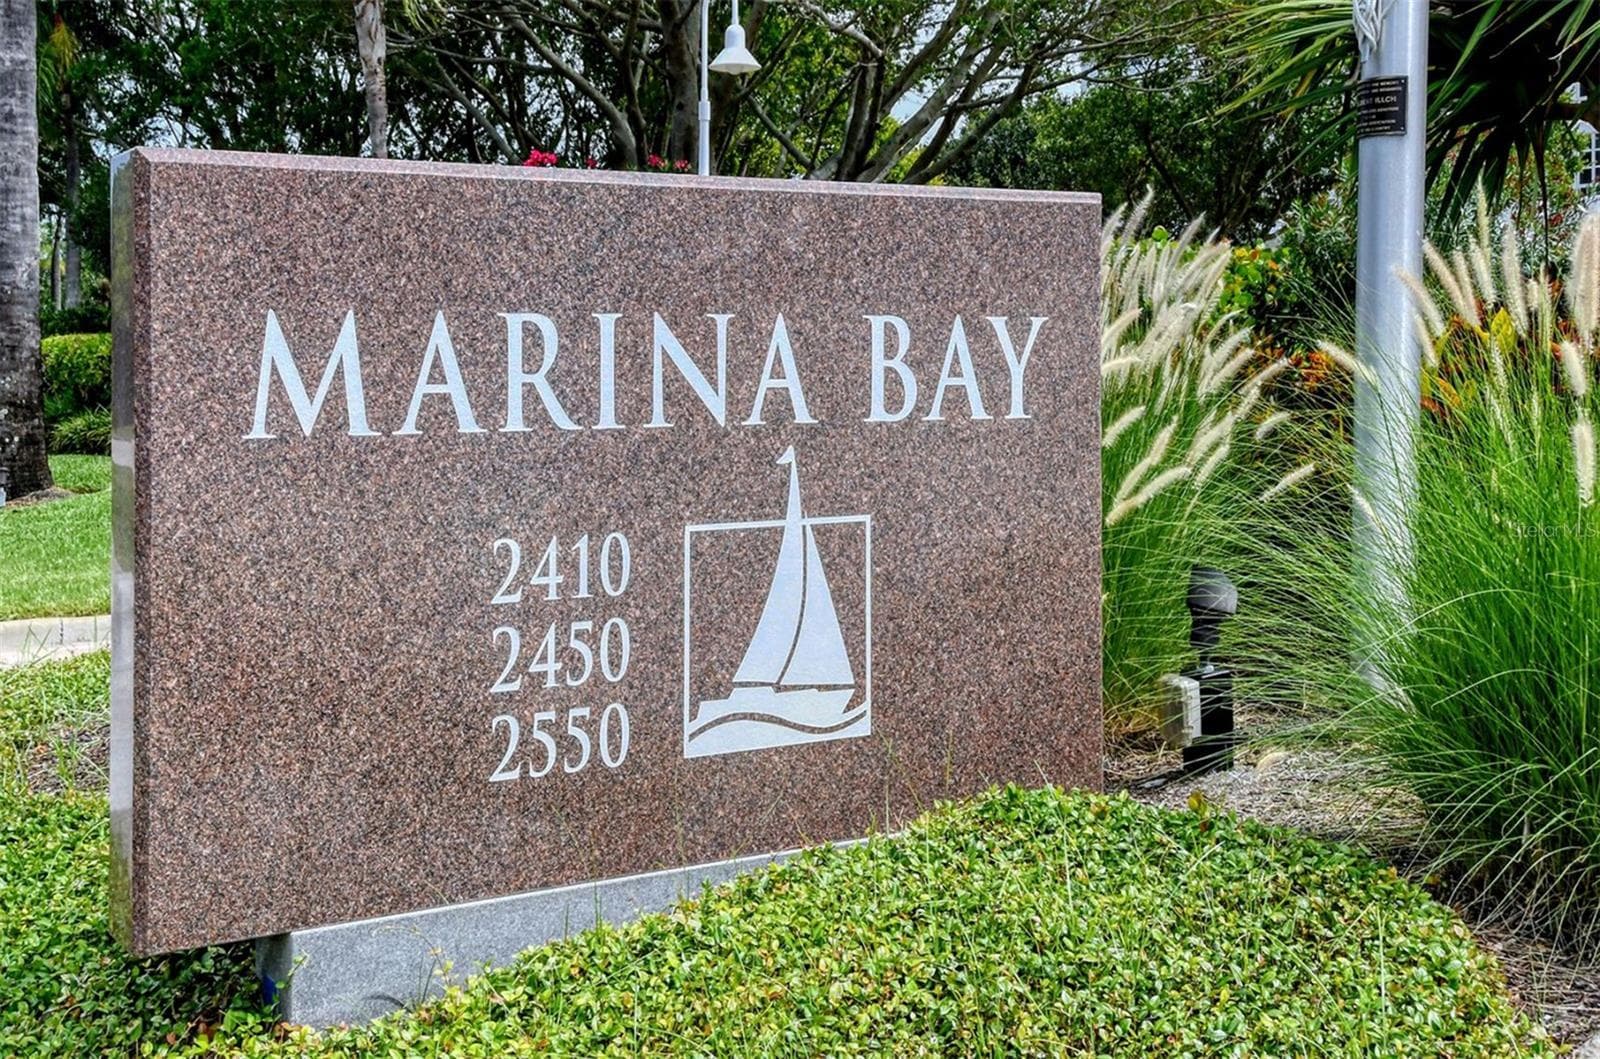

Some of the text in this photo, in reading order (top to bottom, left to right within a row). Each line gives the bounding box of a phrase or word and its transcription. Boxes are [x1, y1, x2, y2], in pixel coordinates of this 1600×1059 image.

[243, 308, 1048, 439] MARINA BAY
[490, 532, 631, 605] 2410
[489, 617, 631, 693] 2450
[489, 702, 631, 782] 2550
